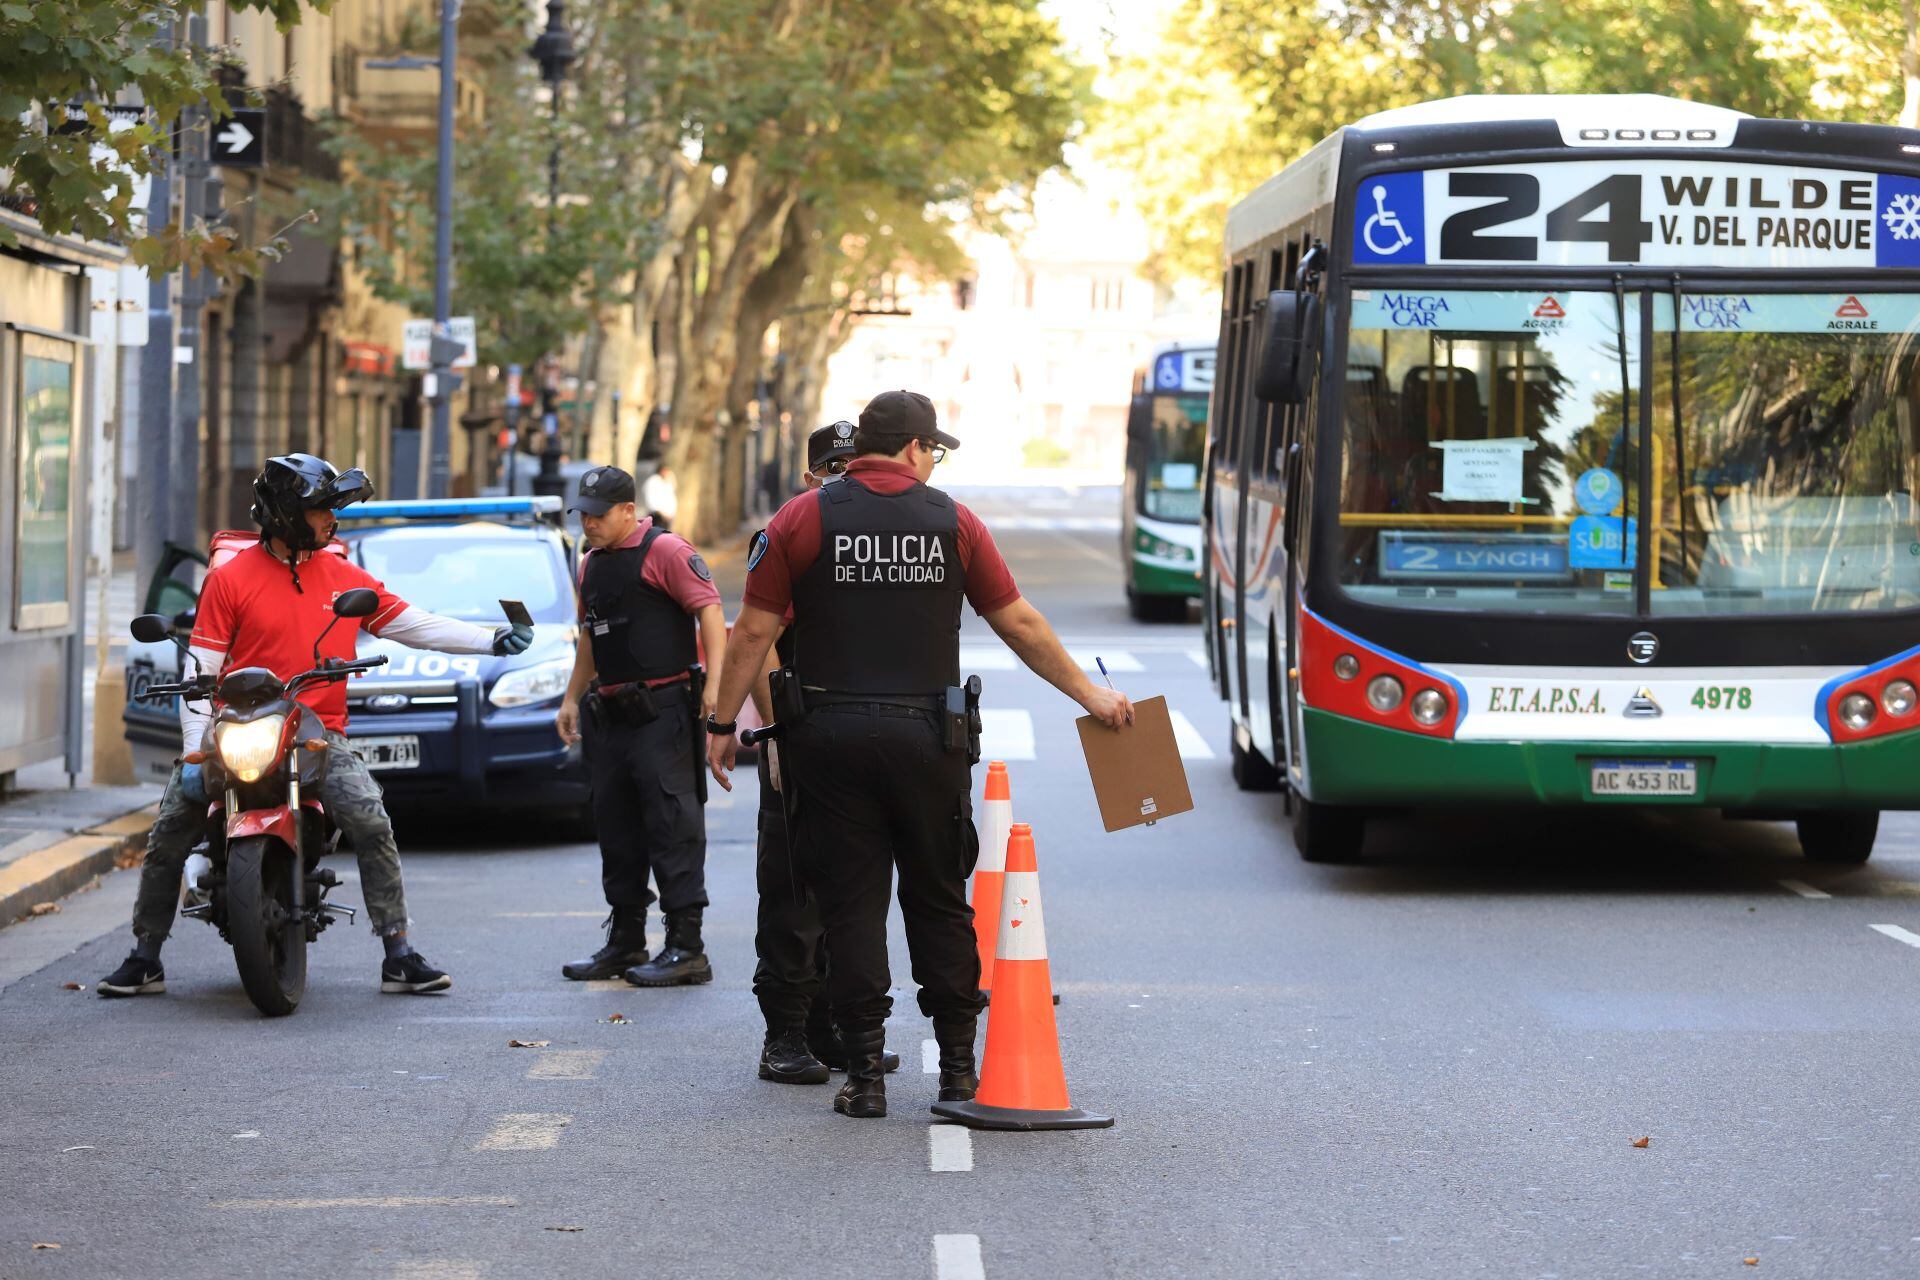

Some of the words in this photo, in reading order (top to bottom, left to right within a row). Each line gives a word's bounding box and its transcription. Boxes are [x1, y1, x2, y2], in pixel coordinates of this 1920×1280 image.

[1660, 175, 1873, 211] WILDE
[1440, 172, 1653, 262] 24
[1659, 214, 1682, 245] V.
[1693, 215, 1747, 247] DEL
[1756, 217, 1872, 251] PARQUE
[1380, 293, 1451, 313] MEGA
[1682, 295, 1753, 313] MEGA
[1391, 310, 1439, 327] CAR
[1694, 311, 1741, 328] CAR
[1826, 320, 1879, 330] AGRALE
[835, 534, 945, 563] POLICIA
[1401, 545, 1440, 570] 2
[1455, 550, 1550, 567] LYNCH
[835, 565, 856, 582] DE
[862, 565, 883, 582] LA
[888, 565, 945, 583] CIUDAD
[1488, 686, 1607, 714] E.T.A.P.S.A.
[1690, 686, 1752, 710] 4978
[1597, 772, 1620, 790] AC
[1626, 773, 1661, 790] 453
[1668, 773, 1691, 790] RL
